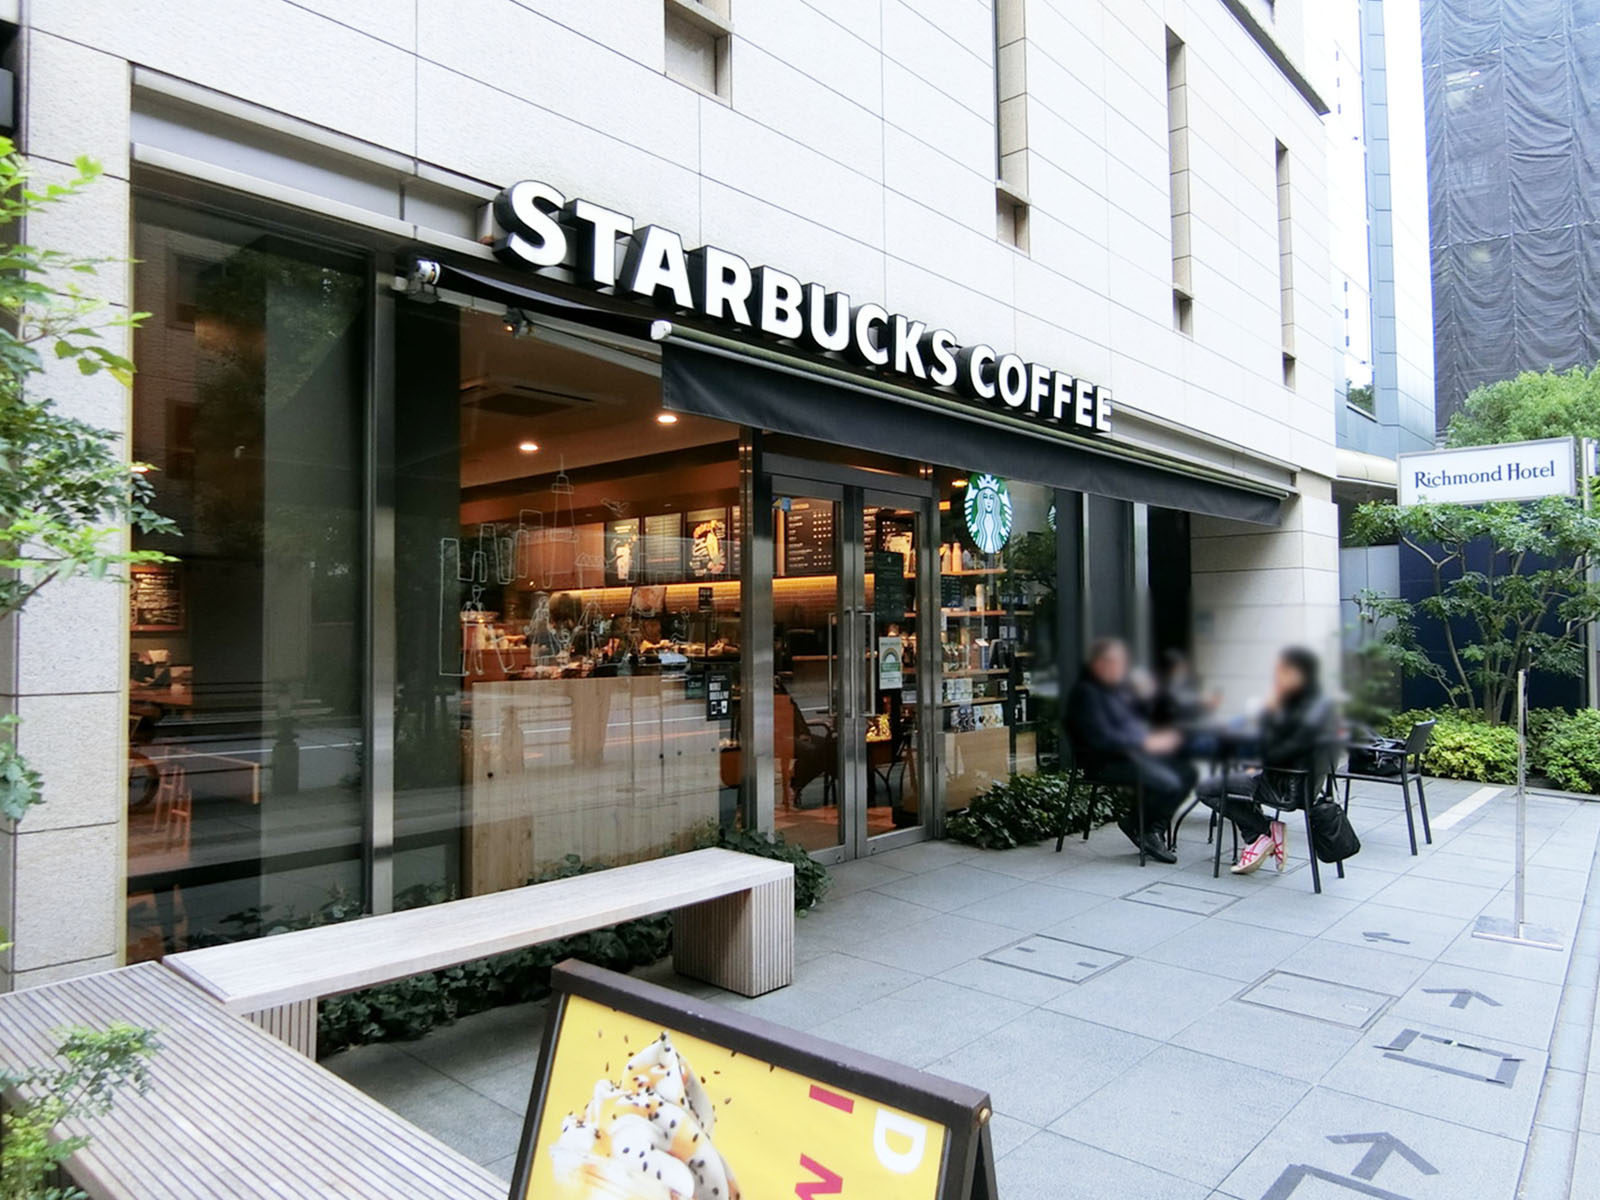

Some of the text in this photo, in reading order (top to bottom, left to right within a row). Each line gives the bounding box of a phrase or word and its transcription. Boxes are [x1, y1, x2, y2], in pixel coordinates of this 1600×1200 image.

[500, 179, 1113, 433] STARBUCKS COFFEE
[1415, 460, 1555, 489] Richmond Hotel
